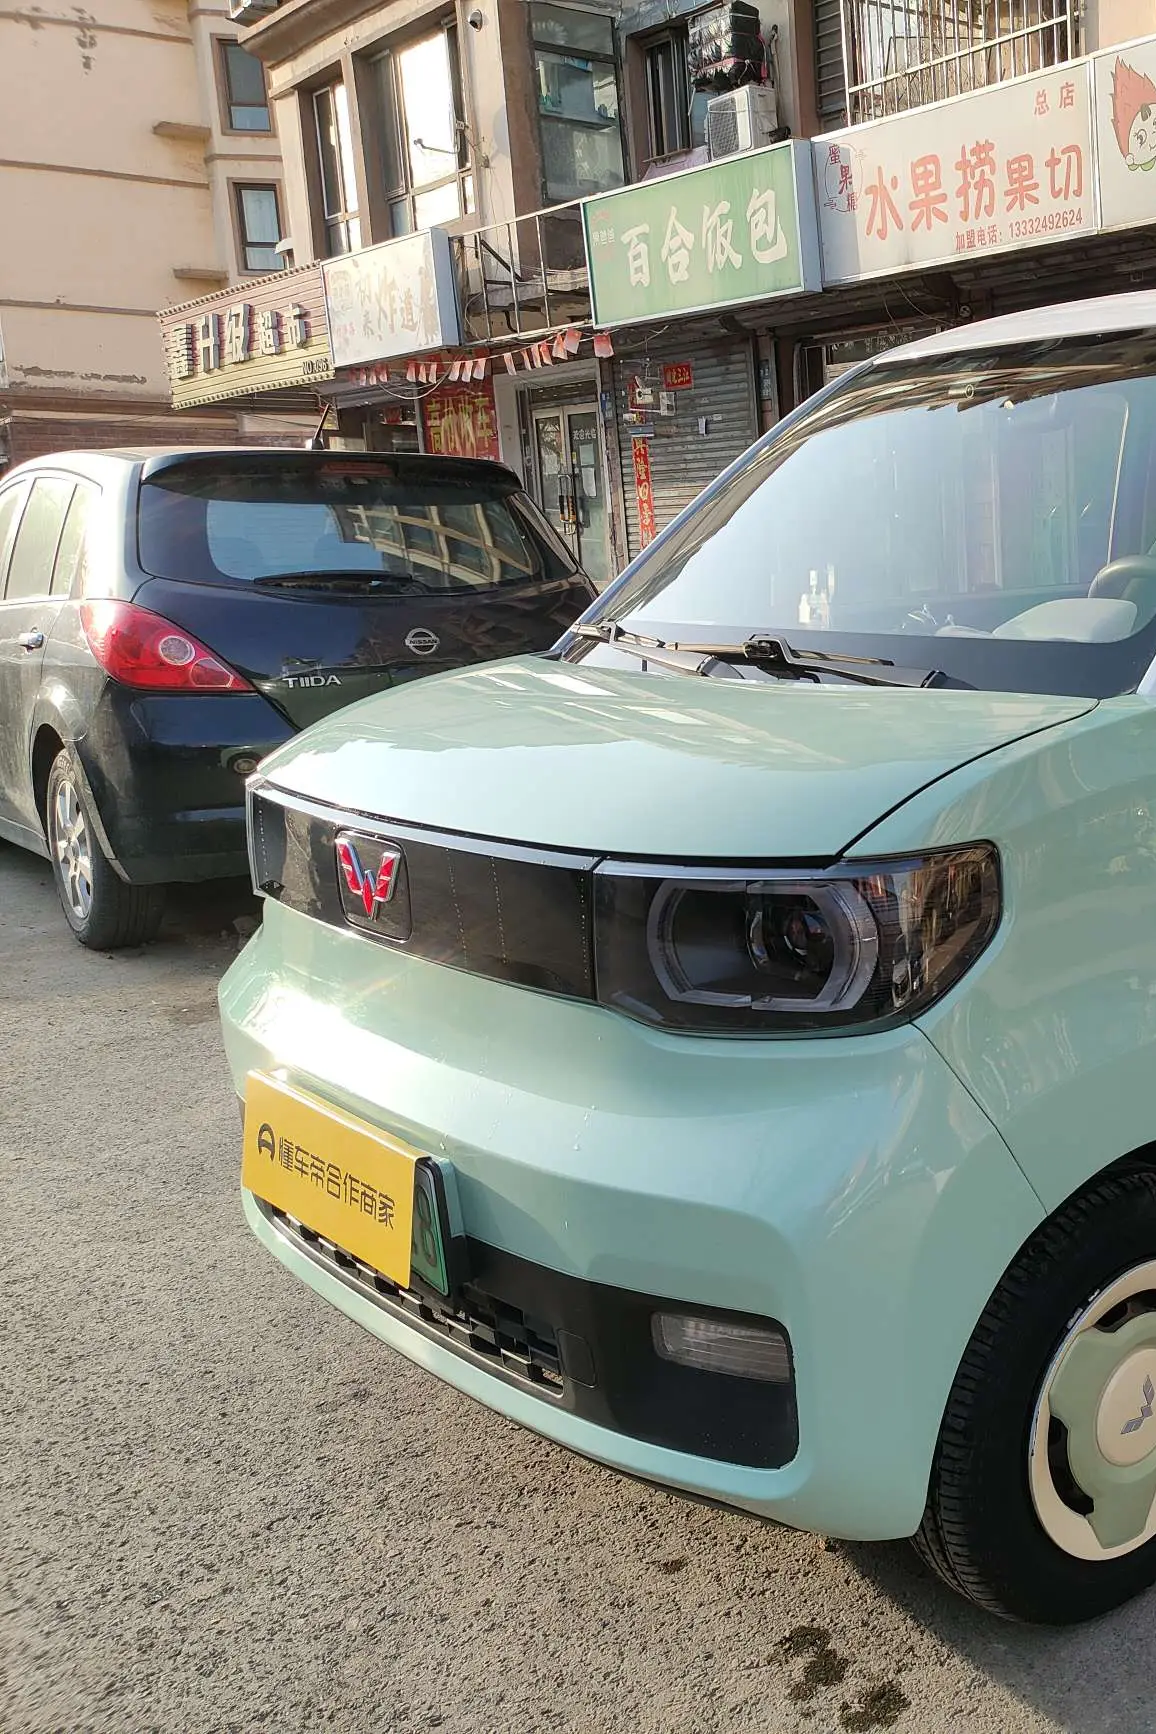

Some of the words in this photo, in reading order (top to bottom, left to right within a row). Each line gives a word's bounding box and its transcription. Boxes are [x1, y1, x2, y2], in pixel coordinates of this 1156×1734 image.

[1034, 81, 1076, 116] 总店
[865, 139, 1085, 241] 水果捞果切
[621, 189, 788, 288] 百合饭包
[1008, 208, 1082, 239] 13332492624
[282, 675, 342, 689] TIIDA
[279, 1137, 395, 1231] 懂车帝合作商家
